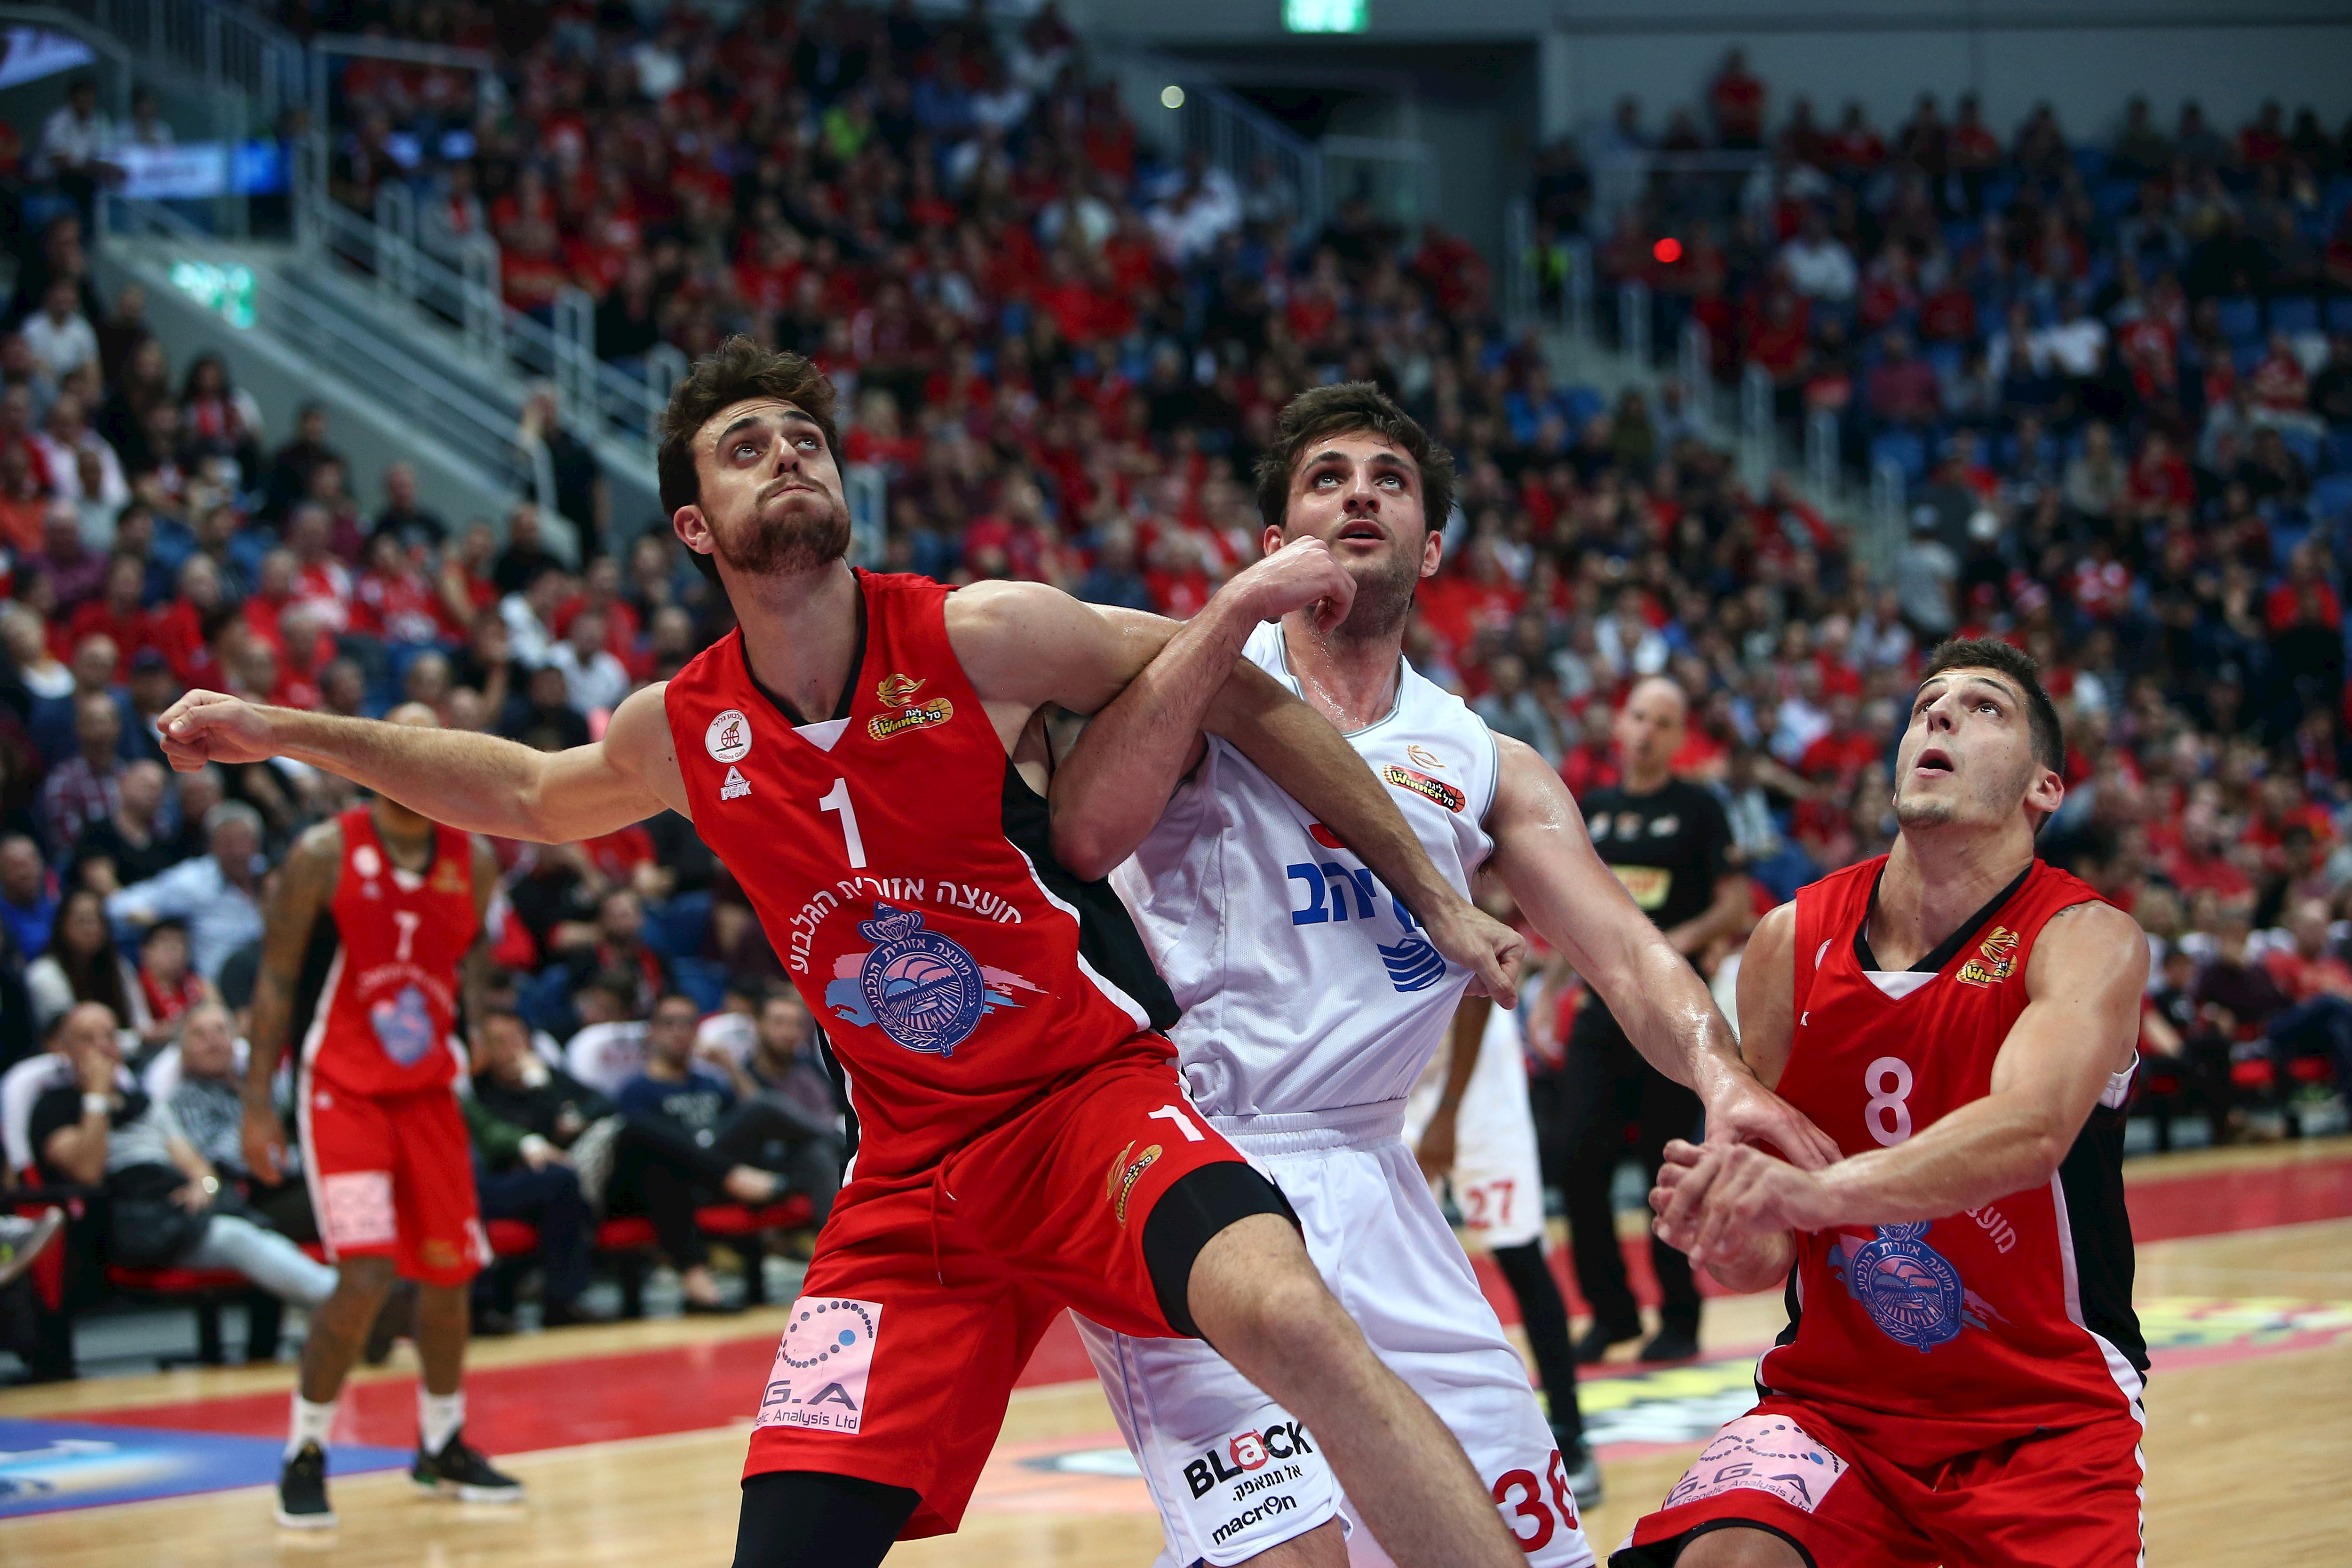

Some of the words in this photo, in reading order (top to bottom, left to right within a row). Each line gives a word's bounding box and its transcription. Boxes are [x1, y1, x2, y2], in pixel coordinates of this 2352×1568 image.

[714, 716, 726, 727] גליל
[878, 716, 926, 734] Winner
[925, 711, 941, 721] סל
[735, 748, 746, 757] Galil
[720, 780, 752, 801] PEAK
[1391, 770, 1442, 799] Winner
[1425, 780, 1443, 793] ליגת
[1443, 793, 1454, 806] סל
[819, 777, 867, 869] 1
[836, 876, 924, 901] אזורית
[1287, 862, 1377, 926] יהב
[790, 890, 839, 974] הגלבוע
[882, 939, 926, 962] אזורית
[933, 942, 971, 976] מועצה
[865, 962, 883, 1008] הגלבוע
[1865, 1056, 1913, 1147] 8
[1148, 1104, 1205, 1142] 1
[1465, 1178, 1515, 1230] 27
[1880, 1242, 1920, 1256] אזורית
[1857, 1251, 1875, 1292] הגלבוע
[1924, 1257, 1955, 1291] מועצה
[773, 1409, 829, 1425] Analysis
[835, 1414, 858, 1429] Ltd
[1284, 1464, 1303, 1480] אל
[1492, 1449, 1578, 1553] 36
[1730, 1480, 1787, 1497] Analysis
[1212, 1495, 1297, 1546] macron
